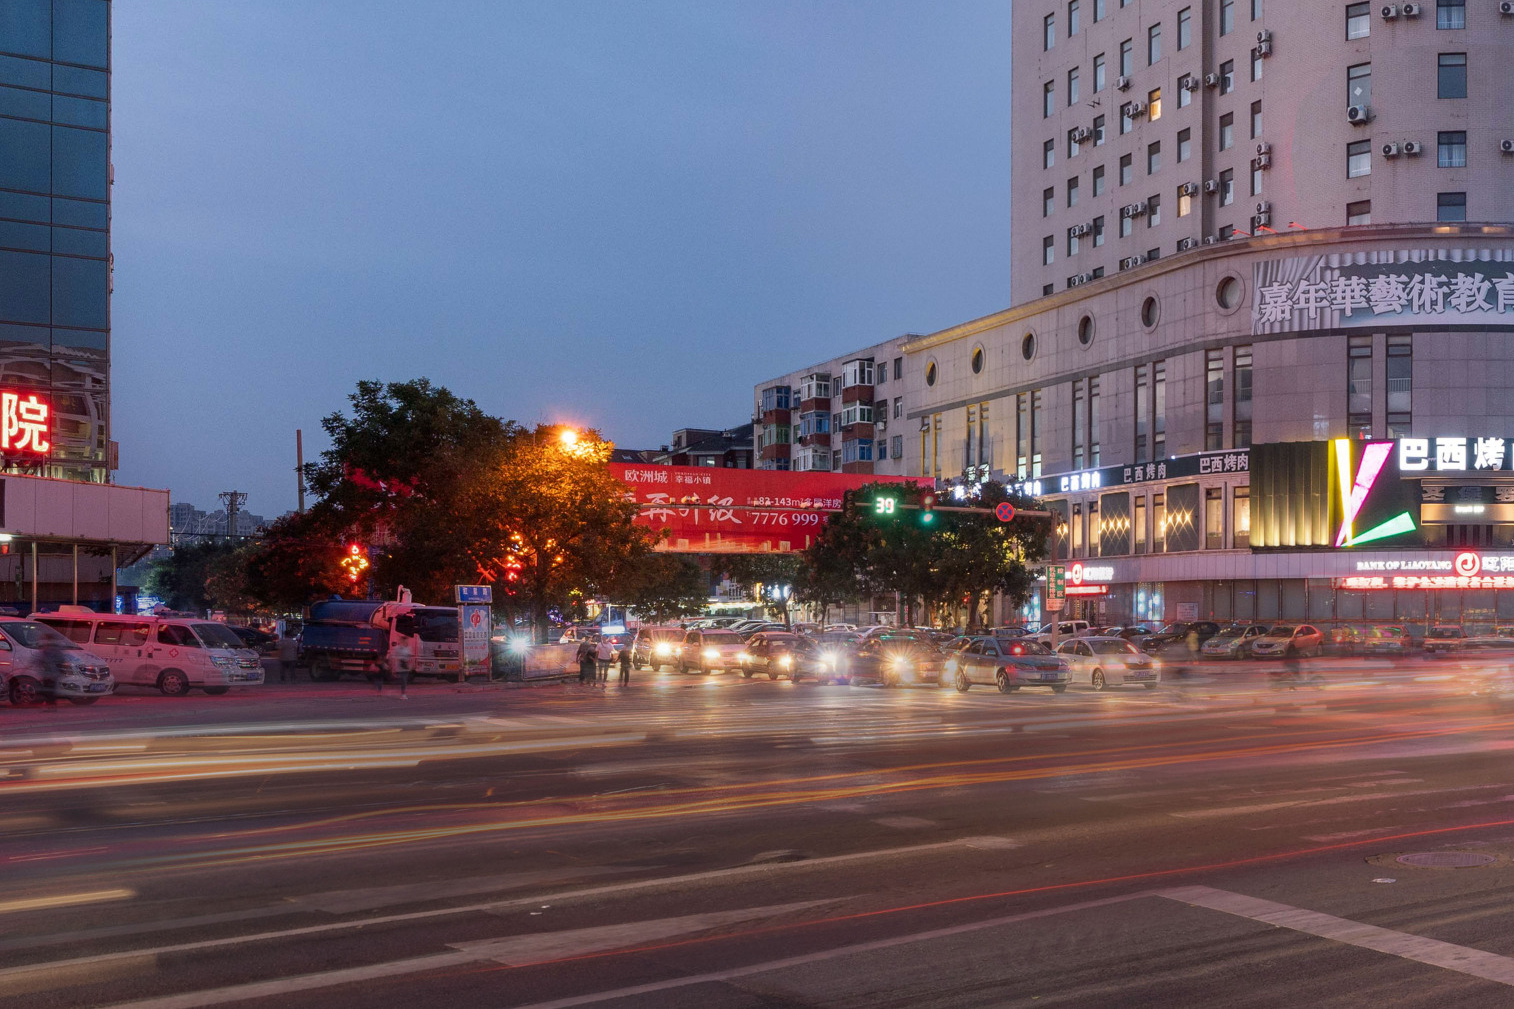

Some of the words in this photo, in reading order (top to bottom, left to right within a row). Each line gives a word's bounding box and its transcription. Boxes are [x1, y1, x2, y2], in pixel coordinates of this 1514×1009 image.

[1, 394, 49, 453] 院
[1200, 453, 1249, 474] 巴西烤肉
[625, 469, 668, 484] 欧洲城
[675, 475, 711, 485] 幸福小镇
[1061, 471, 1100, 492] 巴西烤肉
[1124, 463, 1167, 483] 巴西烤肉
[876, 497, 895, 514] 39
[752, 512, 788, 526] 7776
[792, 513, 819, 526] 999
[1357, 561, 1386, 570] BANK
[1386, 561, 1400, 570] OF
